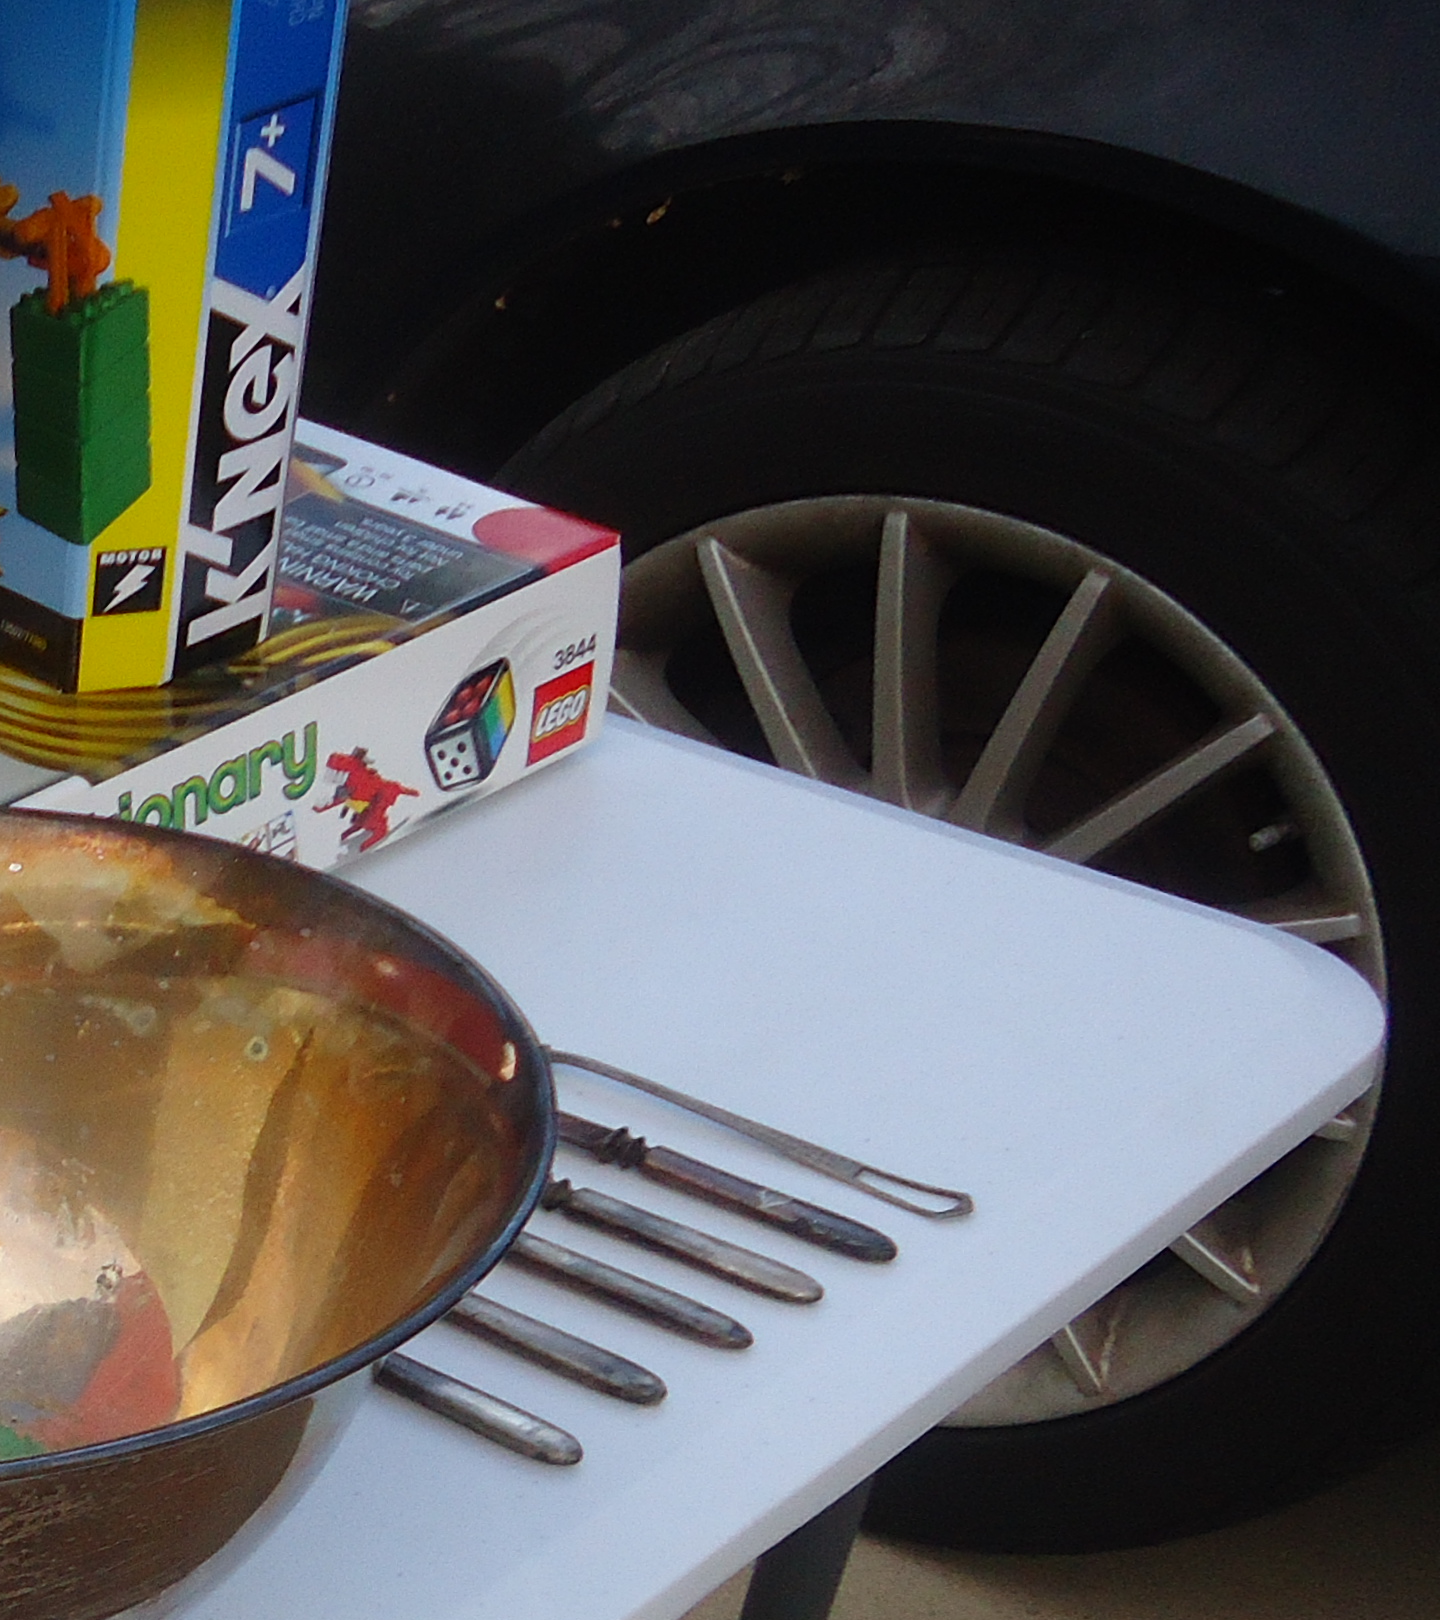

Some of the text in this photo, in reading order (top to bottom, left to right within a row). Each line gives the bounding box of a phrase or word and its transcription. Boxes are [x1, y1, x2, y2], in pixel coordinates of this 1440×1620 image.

[100, 548, 163, 566] MOTOR
[280, 556, 379, 603] WARNIN
[554, 633, 597, 670] 3844
[533, 687, 588, 740] LEGO
